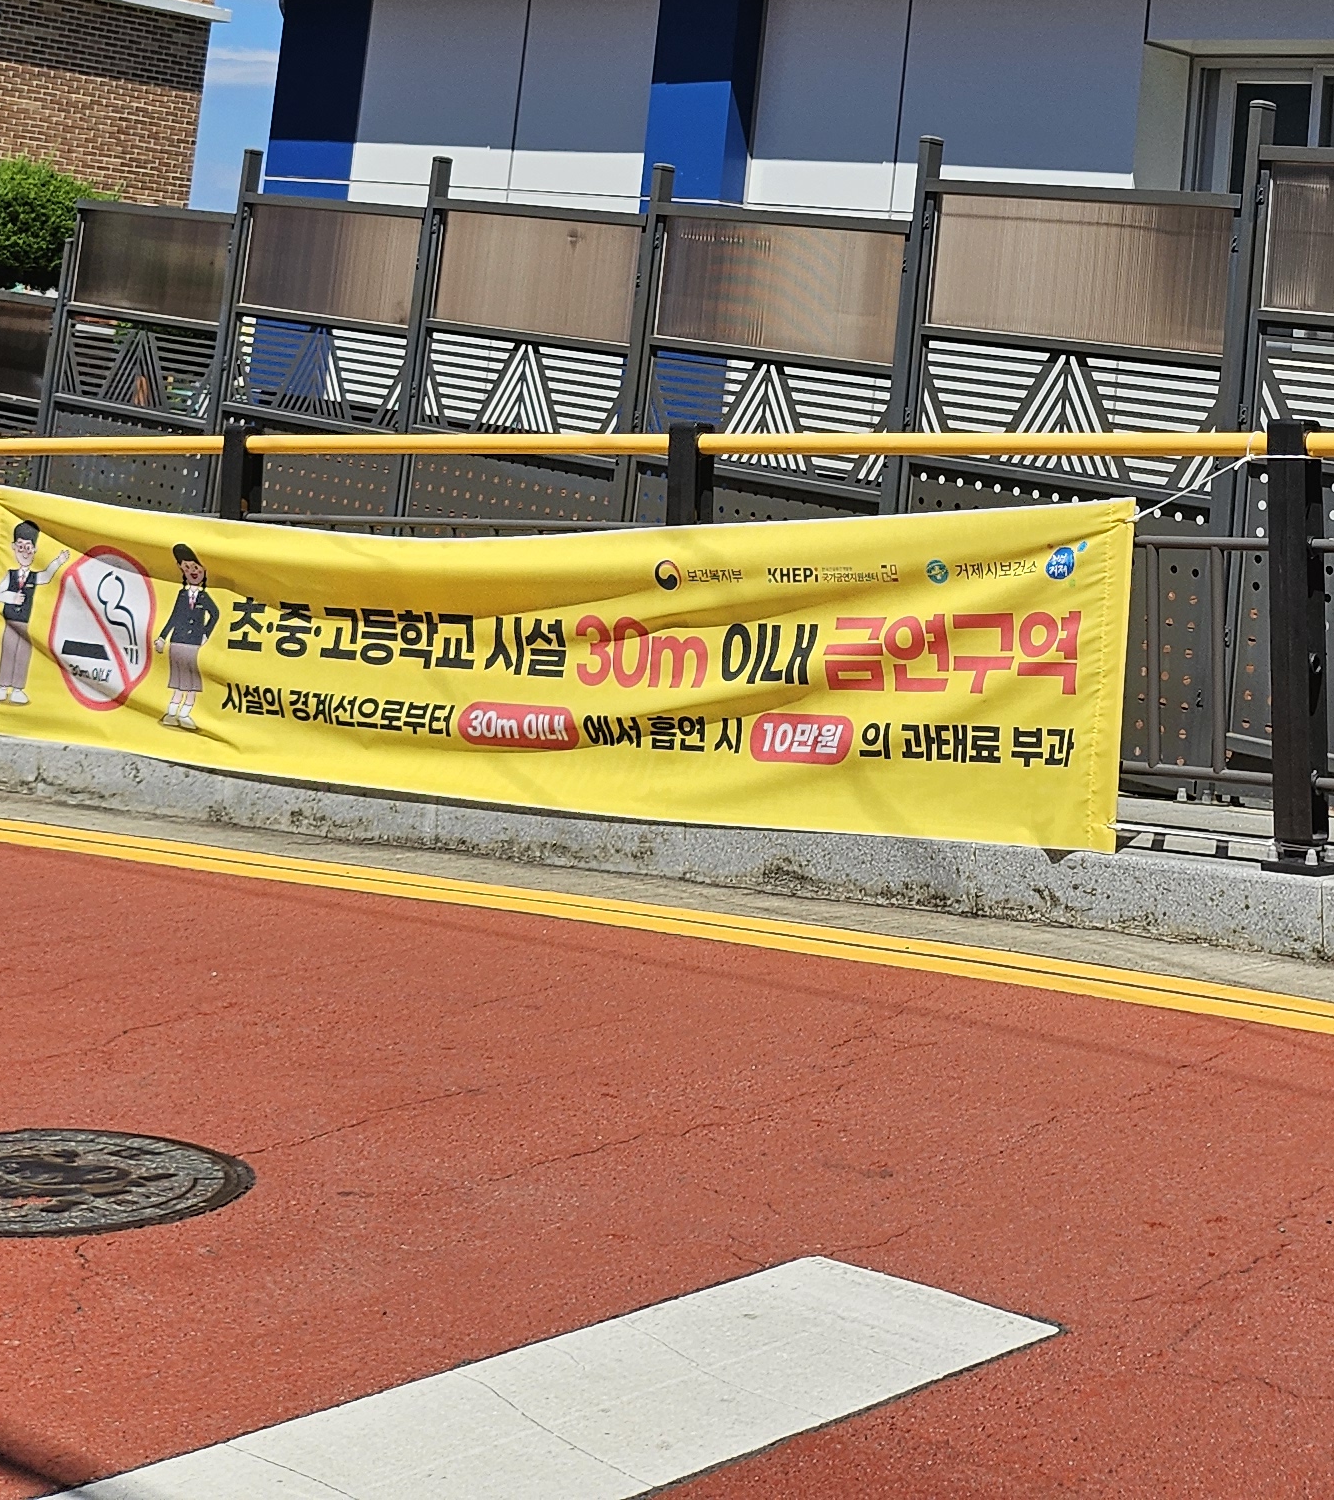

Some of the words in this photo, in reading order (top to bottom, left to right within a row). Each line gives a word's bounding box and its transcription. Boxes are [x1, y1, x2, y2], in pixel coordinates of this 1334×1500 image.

[686, 568, 743, 583] 보건복지부
[821, 572, 880, 583] 국가금연지원센터
[954, 560, 1038, 580] 거제시보건소
[483, 615, 567, 678] 시설
[575, 614, 709, 689] 30m
[721, 622, 819, 685] 이내
[823, 610, 1082, 696] 금연구역
[221, 682, 286, 718] 시설의
[288, 689, 456, 738] 경계선으로부터
[466, 709, 519, 740] 30m
[523, 712, 569, 742] 이내
[582, 714, 642, 749] 에서
[646, 715, 706, 752] 흡연
[713, 717, 743, 754] 시
[761, 722, 844, 754] 10만원
[858, 722, 892, 760] 의
[900, 723, 1002, 764] 과태료
[1010, 726, 1075, 768] 부과
